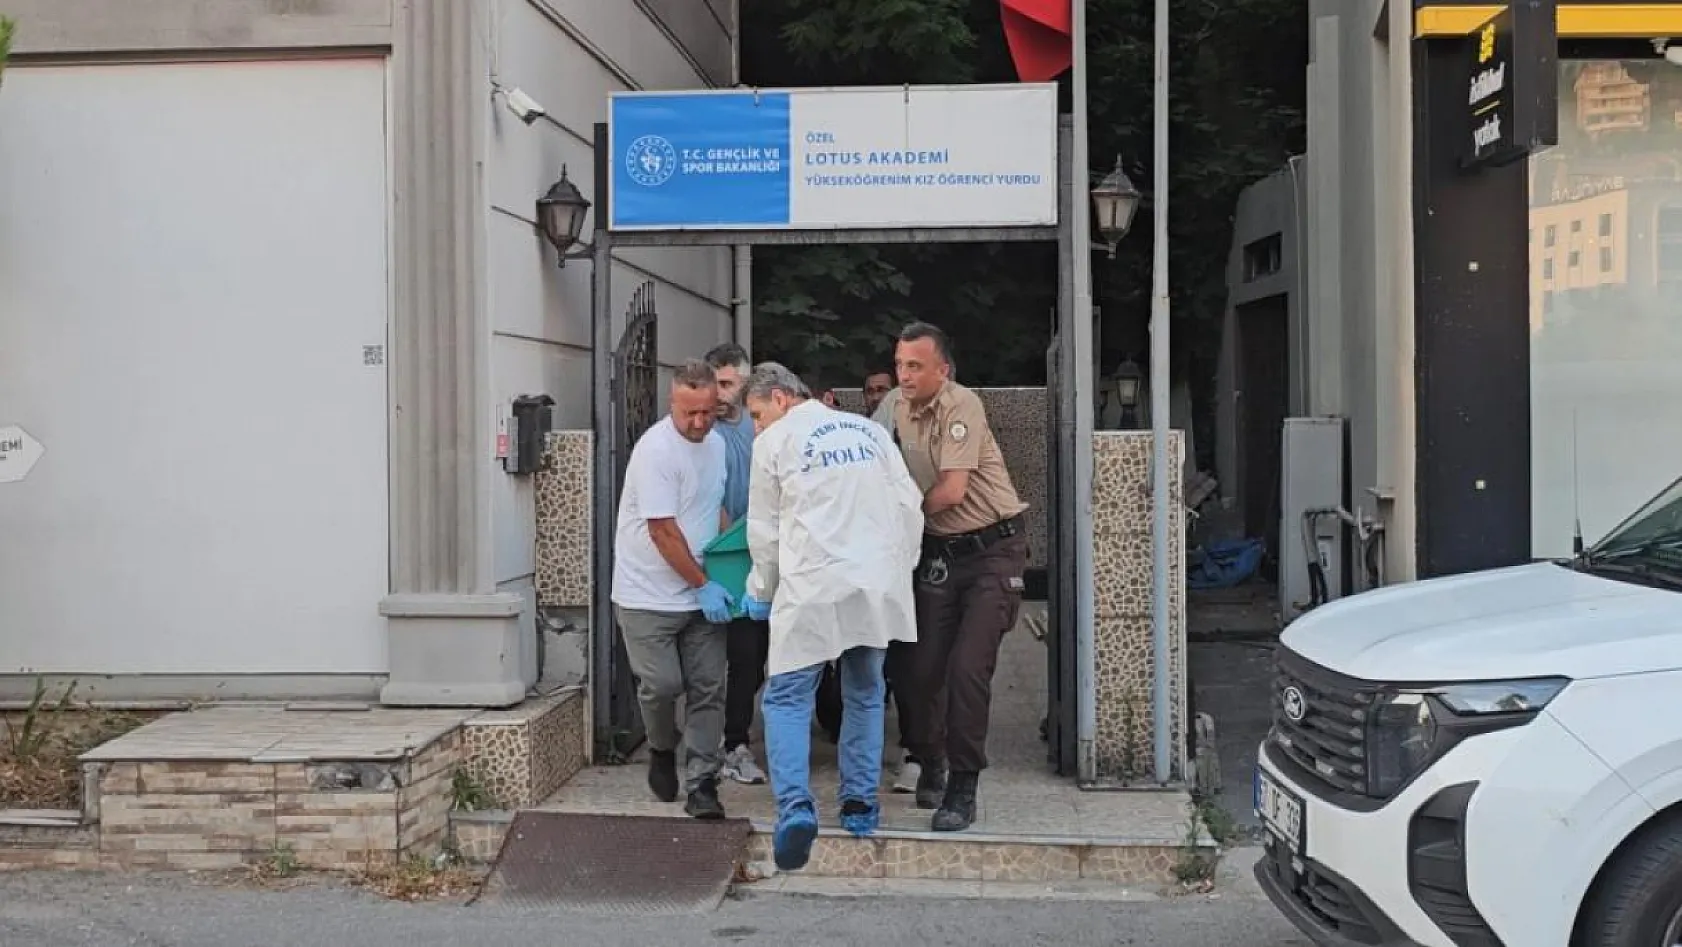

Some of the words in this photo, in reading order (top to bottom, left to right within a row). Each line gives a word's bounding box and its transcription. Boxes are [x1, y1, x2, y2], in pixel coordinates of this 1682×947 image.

[805, 130, 835, 144] ÖZEL
[682, 149, 703, 161] T.C.
[707, 146, 761, 162] GENÇLİK
[764, 148, 780, 160] VE
[805, 151, 862, 165] LOTUS
[868, 148, 949, 165] AKADEMİ
[682, 162, 713, 174] SPOR
[716, 159, 780, 173] BAKANLIĞI
[805, 173, 911, 187] YÜKSEKÖĞRENİM
[915, 175, 936, 186] KIZ
[938, 171, 994, 186] ÖĞRENCİ
[996, 174, 1041, 185] YURDU
